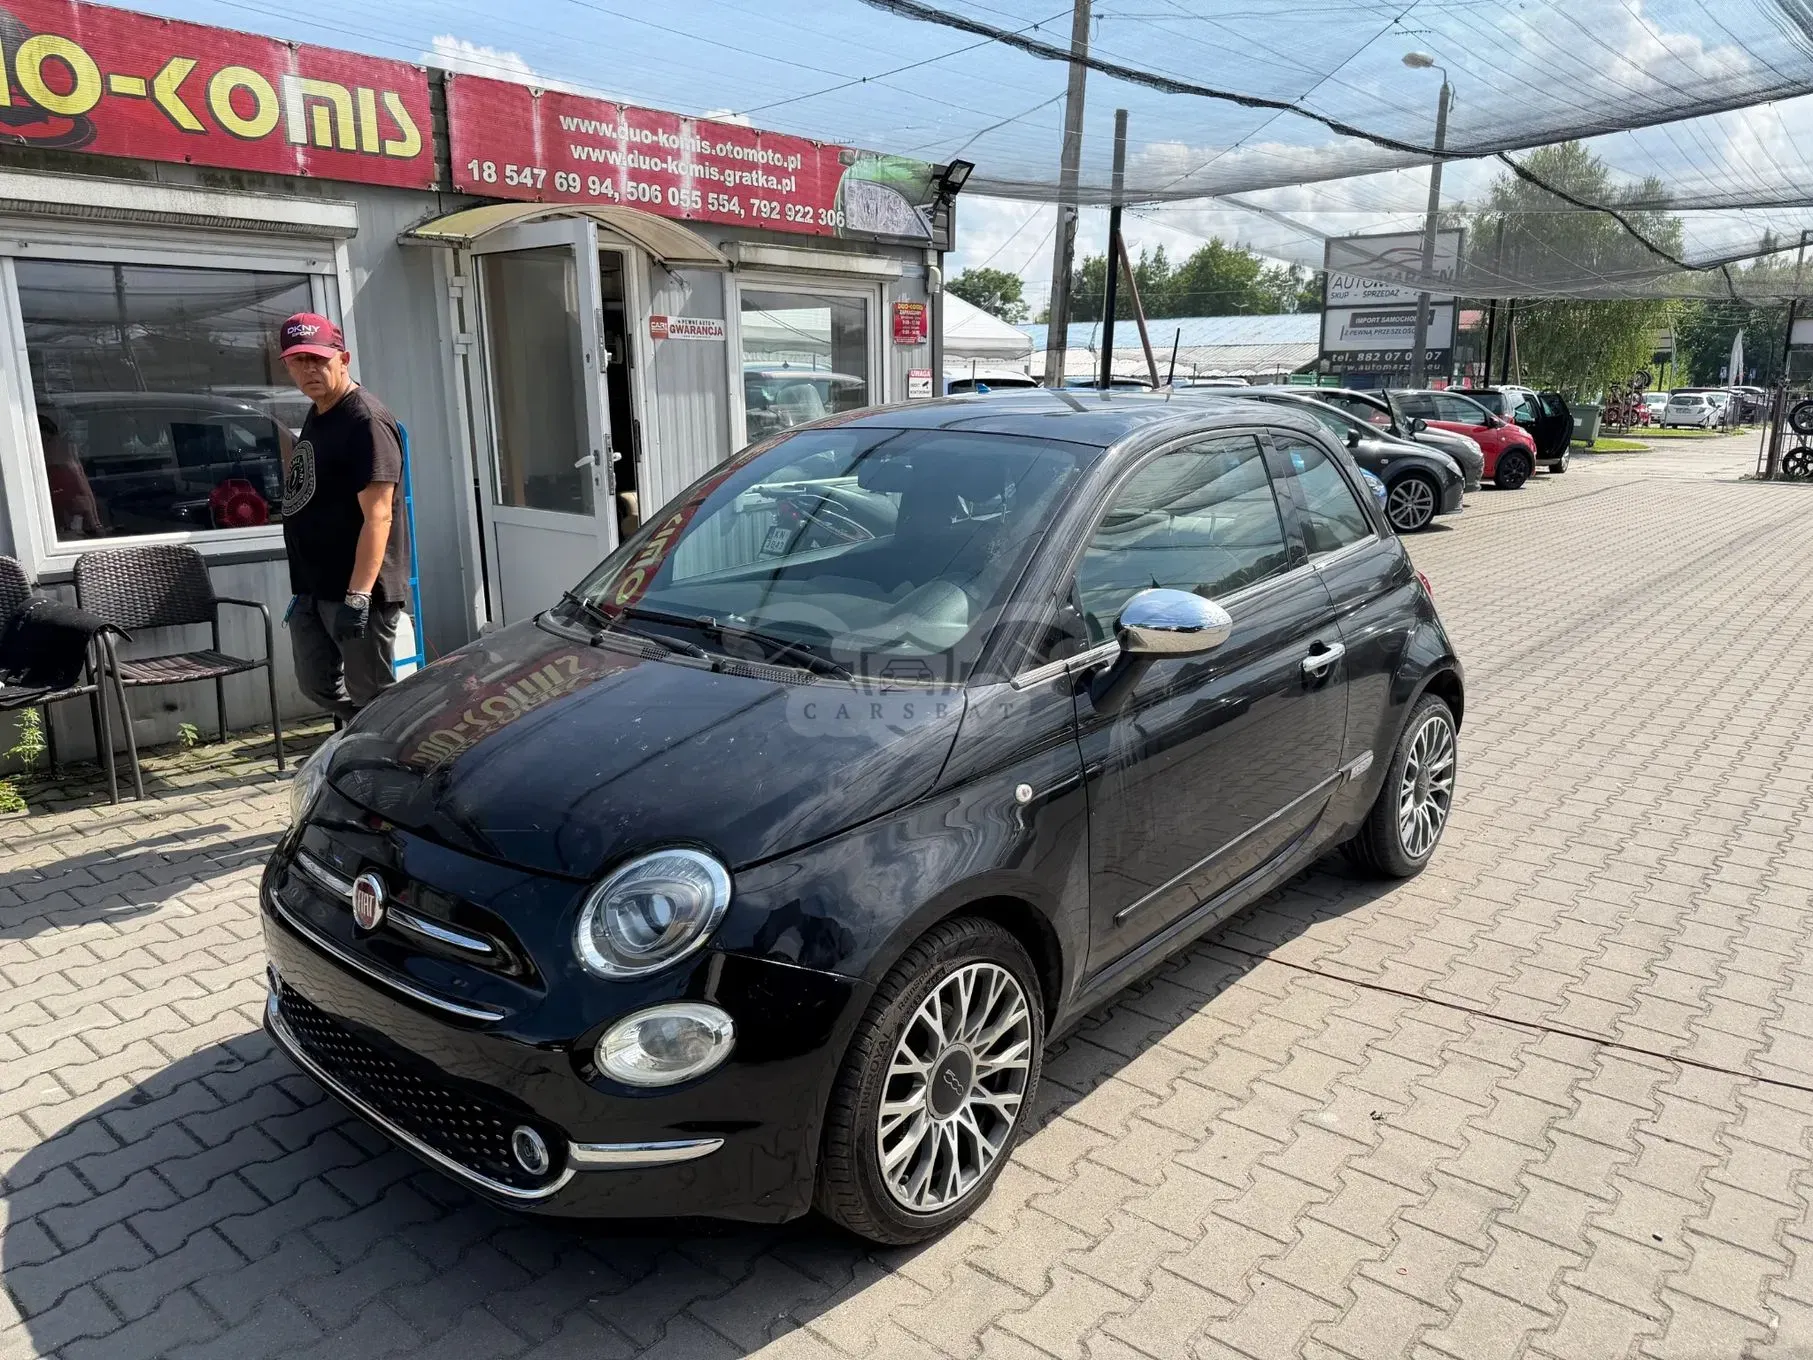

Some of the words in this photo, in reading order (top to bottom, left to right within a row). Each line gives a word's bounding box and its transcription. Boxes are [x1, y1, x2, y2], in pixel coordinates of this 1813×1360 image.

[559, 114, 801, 171] www.duo-komis.otomoto.pl
[570, 144, 796, 194] www.duo-komis.gratka.pl
[467, 158, 498, 183] 18
[505, 163, 547, 189] 547
[554, 172, 581, 194] 69
[588, 175, 621, 203] 94,
[626, 180, 662, 204] 506
[668, 187, 702, 209] 055
[707, 192, 745, 219] 554,
[750, 198, 781, 220] 792
[785, 205, 814, 224] 922
[818, 207, 845, 228] 306
[1331, 291, 1349, 299] SKUP
[1362, 289, 1400, 298] SPRZEDAŻ
[287, 324, 320, 335] DKNY
[669, 325, 723, 336] GWARANCJA
[1332, 352, 1352, 362] tel.
[1357, 352, 1380, 361] 882
[1384, 352, 1401, 361] 07
[1425, 351, 1442, 360] 07
[356, 889, 375, 918] FIAT
